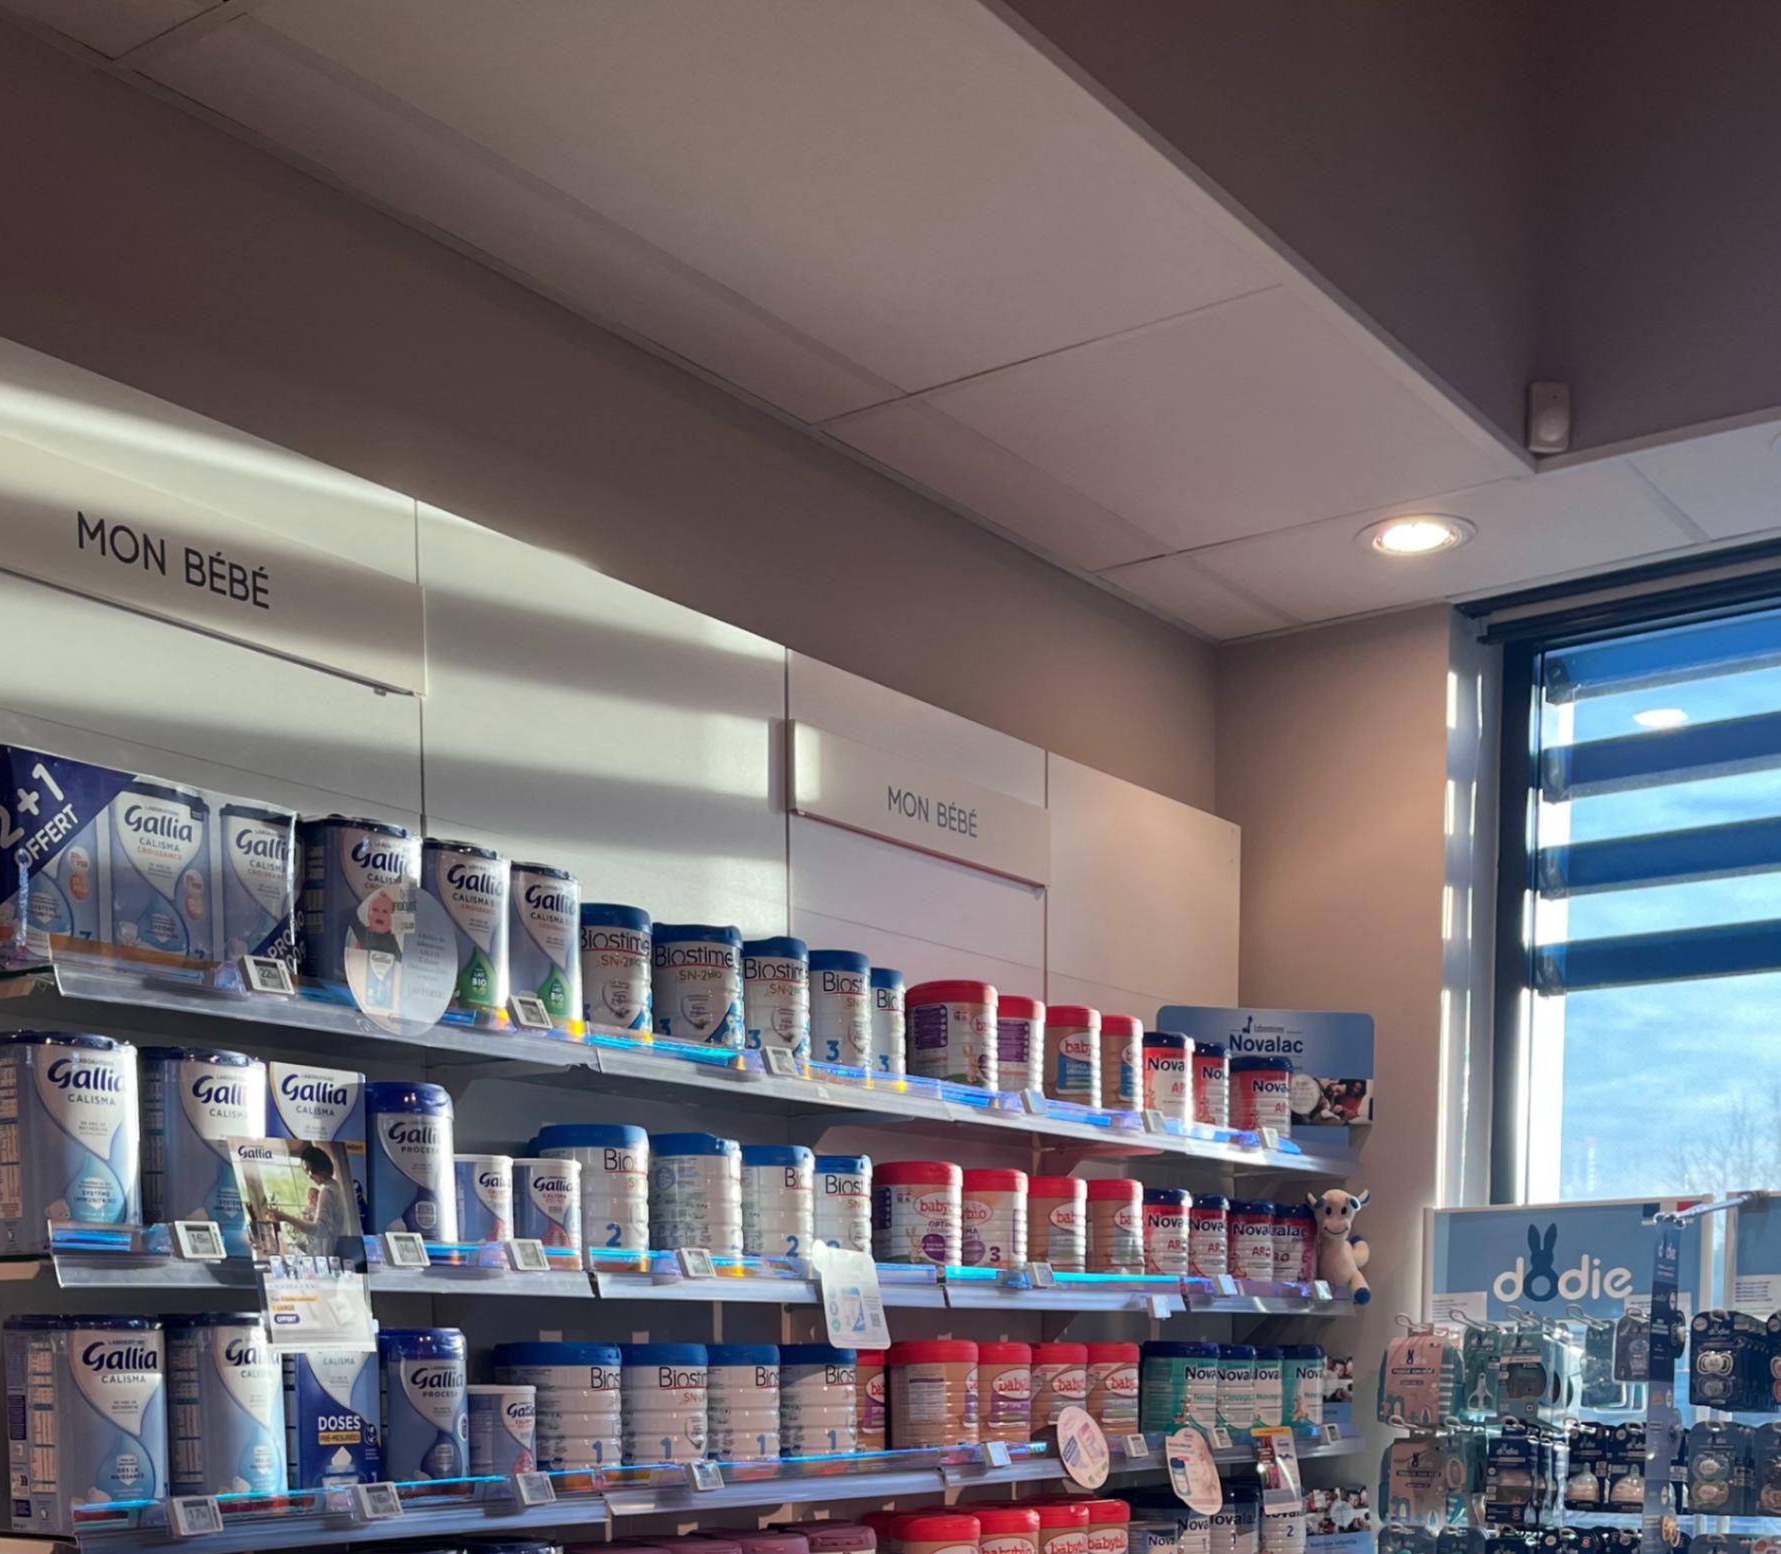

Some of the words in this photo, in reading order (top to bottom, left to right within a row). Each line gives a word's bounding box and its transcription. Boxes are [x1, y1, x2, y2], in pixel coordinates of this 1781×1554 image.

[77, 510, 166, 576] MON
[184, 546, 270, 610] BÉBÉ
[888, 785, 929, 823] MON
[937, 802, 977, 838] BÉBÉ
[124, 804, 194, 843] Gallia
[14, 803, 80, 869] OFFERT
[139, 837, 181, 852] CALISMA
[654, 944, 734, 969] Biostime
[748, 1029, 761, 1050] 3
[1229, 1034, 1303, 1053] Novalac
[826, 1040, 839, 1062] 3
[878, 1055, 889, 1073] 3
[68, 1094, 116, 1106] CALISMA
[281, 1074, 348, 1106] Gallia
[296, 1105, 336, 1118] CALISMA
[238, 1145, 273, 1160] Gallia
[606, 1223, 622, 1247] 2
[786, 1235, 799, 1258] 2
[989, 1247, 1001, 1263] 3
[82, 1342, 158, 1372] Gallia
[323, 1357, 356, 1366] CALISMA
[101, 1375, 147, 1385] CALISMA
[411, 1368, 463, 1389] Gallia
[319, 1415, 361, 1432] DOSES
[661, 1436, 672, 1459] 1
[757, 1434, 766, 1455] 1
[827, 1430, 836, 1450] 1
[592, 1440, 603, 1464] 1
[1286, 1525, 1294, 1537] 2
